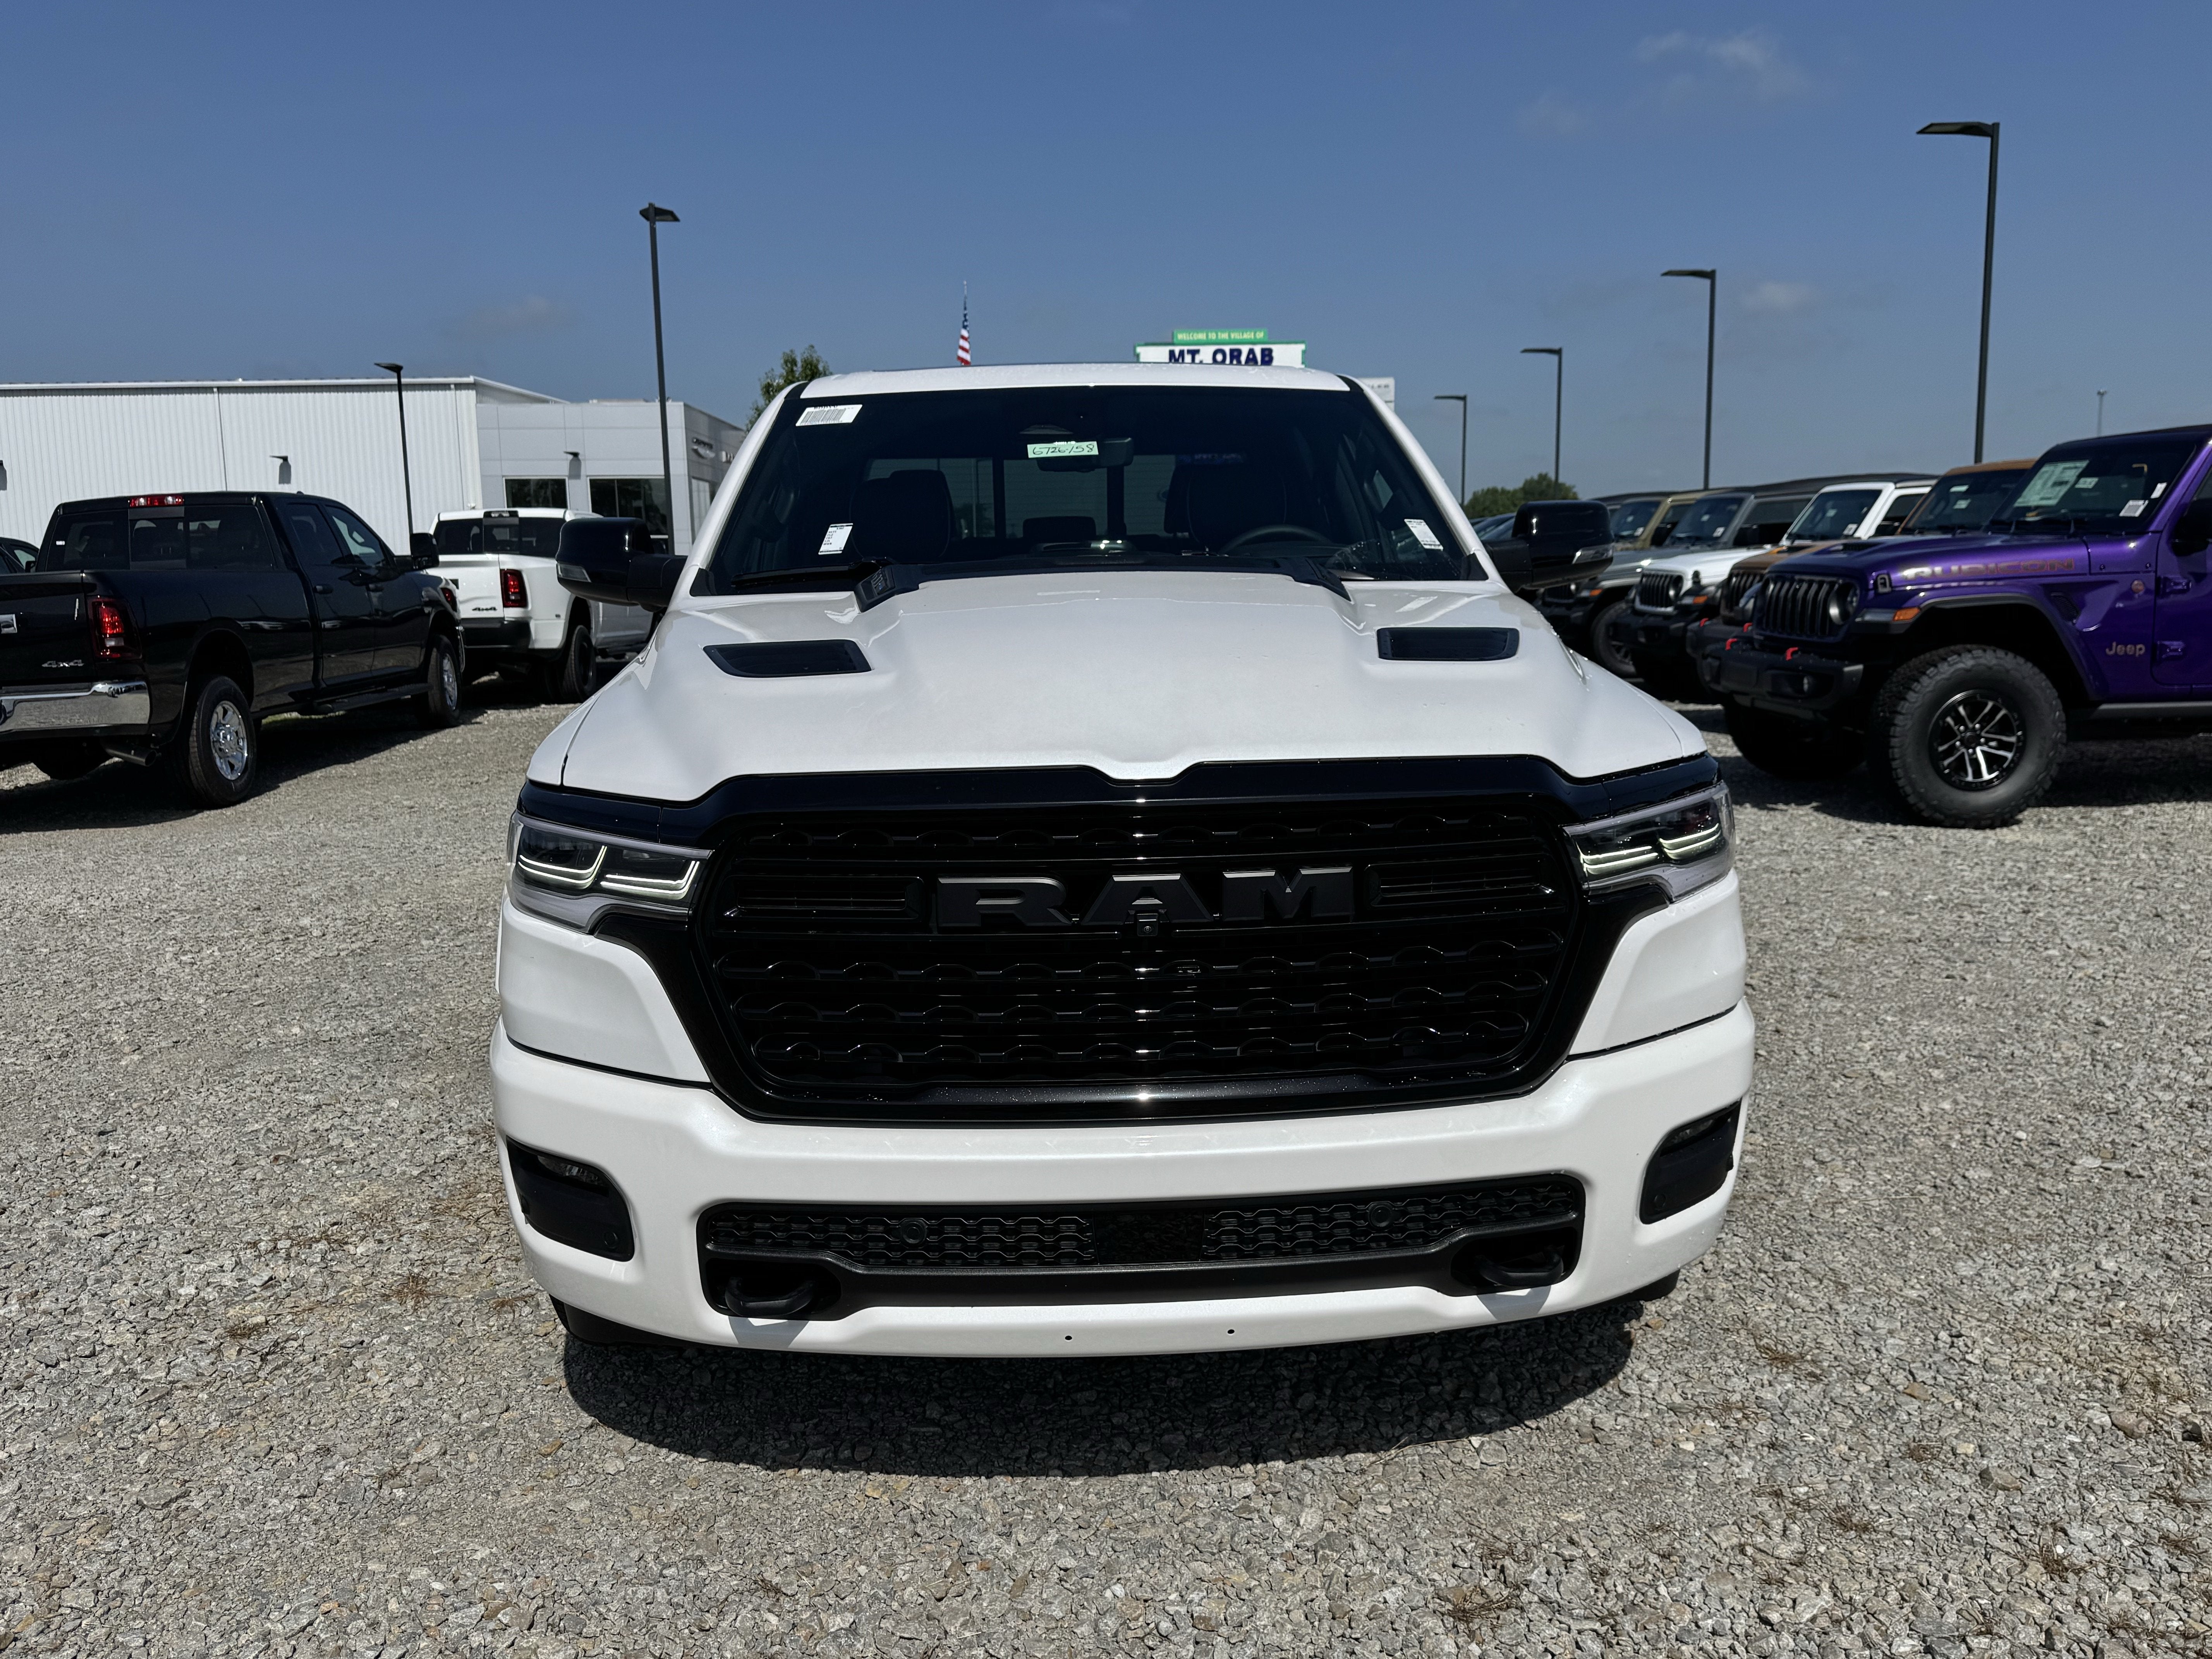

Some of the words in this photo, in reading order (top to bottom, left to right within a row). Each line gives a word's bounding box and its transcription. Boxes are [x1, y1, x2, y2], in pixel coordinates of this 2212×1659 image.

[1231, 331, 1254, 339] VILLAGE
[1255, 331, 1264, 339] OF
[1169, 349, 1203, 363] MT.
[1212, 348, 1273, 366] ORAB
[1902, 558, 2075, 580] RUBICON
[2106, 641, 2145, 657] Jeep
[938, 866, 1354, 926] RAM
